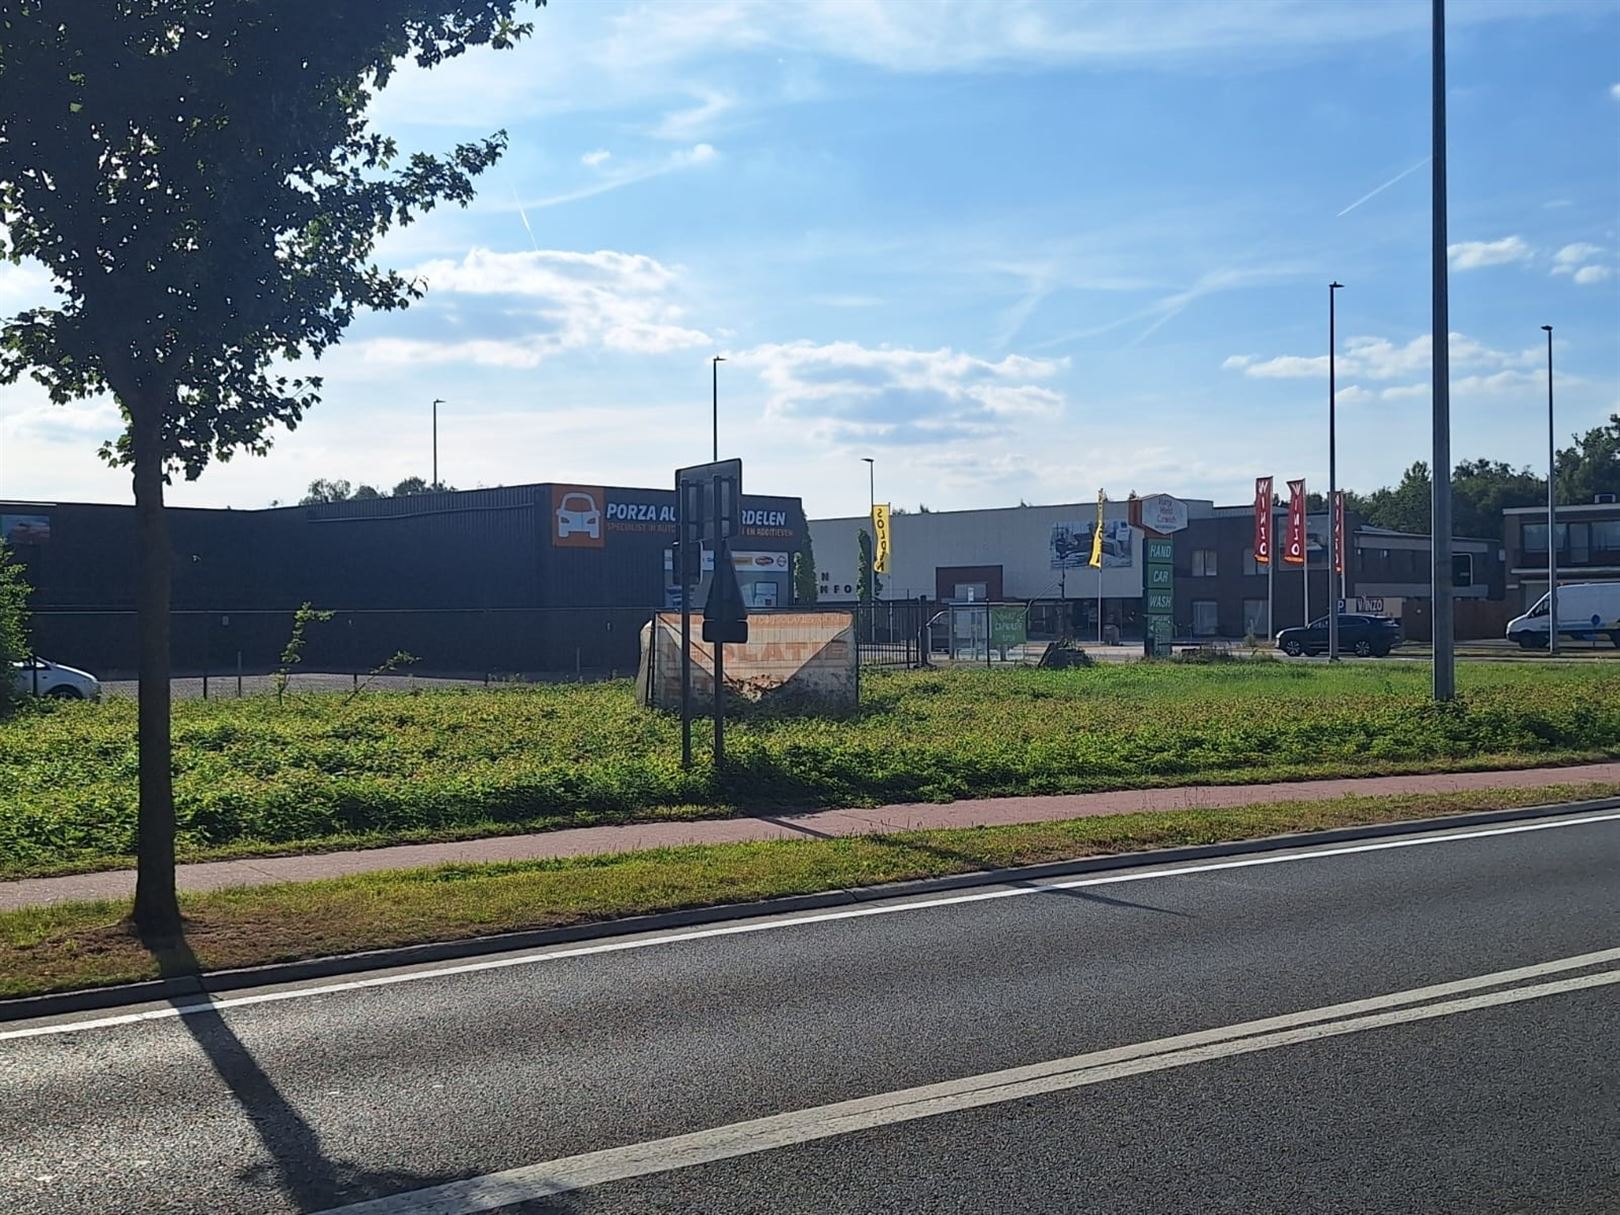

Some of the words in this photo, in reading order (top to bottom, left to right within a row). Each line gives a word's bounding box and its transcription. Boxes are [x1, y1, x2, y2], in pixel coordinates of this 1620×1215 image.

[606, 503, 657, 521] PORZA
[1150, 545, 1172, 558] HAND
[1153, 570, 1169, 583] CAR
[1149, 595, 1172, 608] WASH
